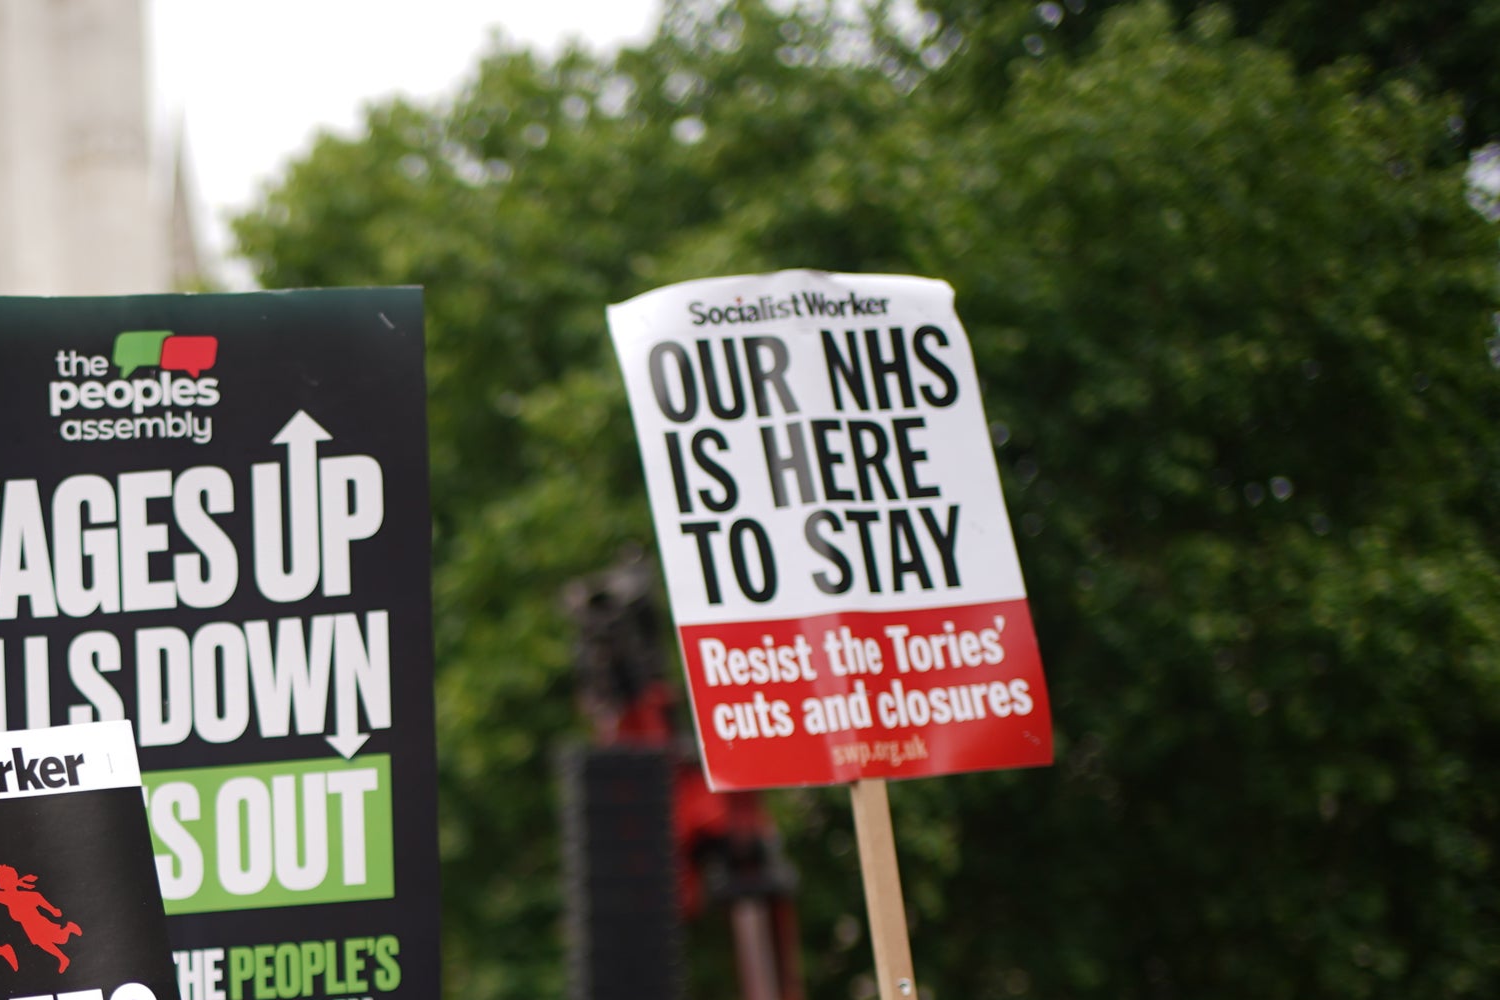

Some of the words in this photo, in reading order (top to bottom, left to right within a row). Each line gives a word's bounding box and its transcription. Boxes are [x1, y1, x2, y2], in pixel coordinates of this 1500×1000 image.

[49, 371, 221, 417] peoples
[56, 350, 109, 377] the
[648, 336, 800, 423] OUR
[820, 325, 959, 411] NHS
[60, 411, 212, 444] assembly
[665, 428, 739, 513] IS
[760, 417, 941, 508] HERE
[252, 455, 384, 602] UP
[681, 518, 779, 605] TO
[804, 505, 961, 594] STAY
[136, 611, 391, 747] DOWN
[700, 636, 817, 686] Resist
[823, 627, 883, 676] the
[714, 693, 794, 740] cuts
[803, 681, 873, 735] and
[879, 679, 1033, 727] closures
[833, 740, 928, 767] swp.org.uk
[215, 768, 379, 896] OUT
